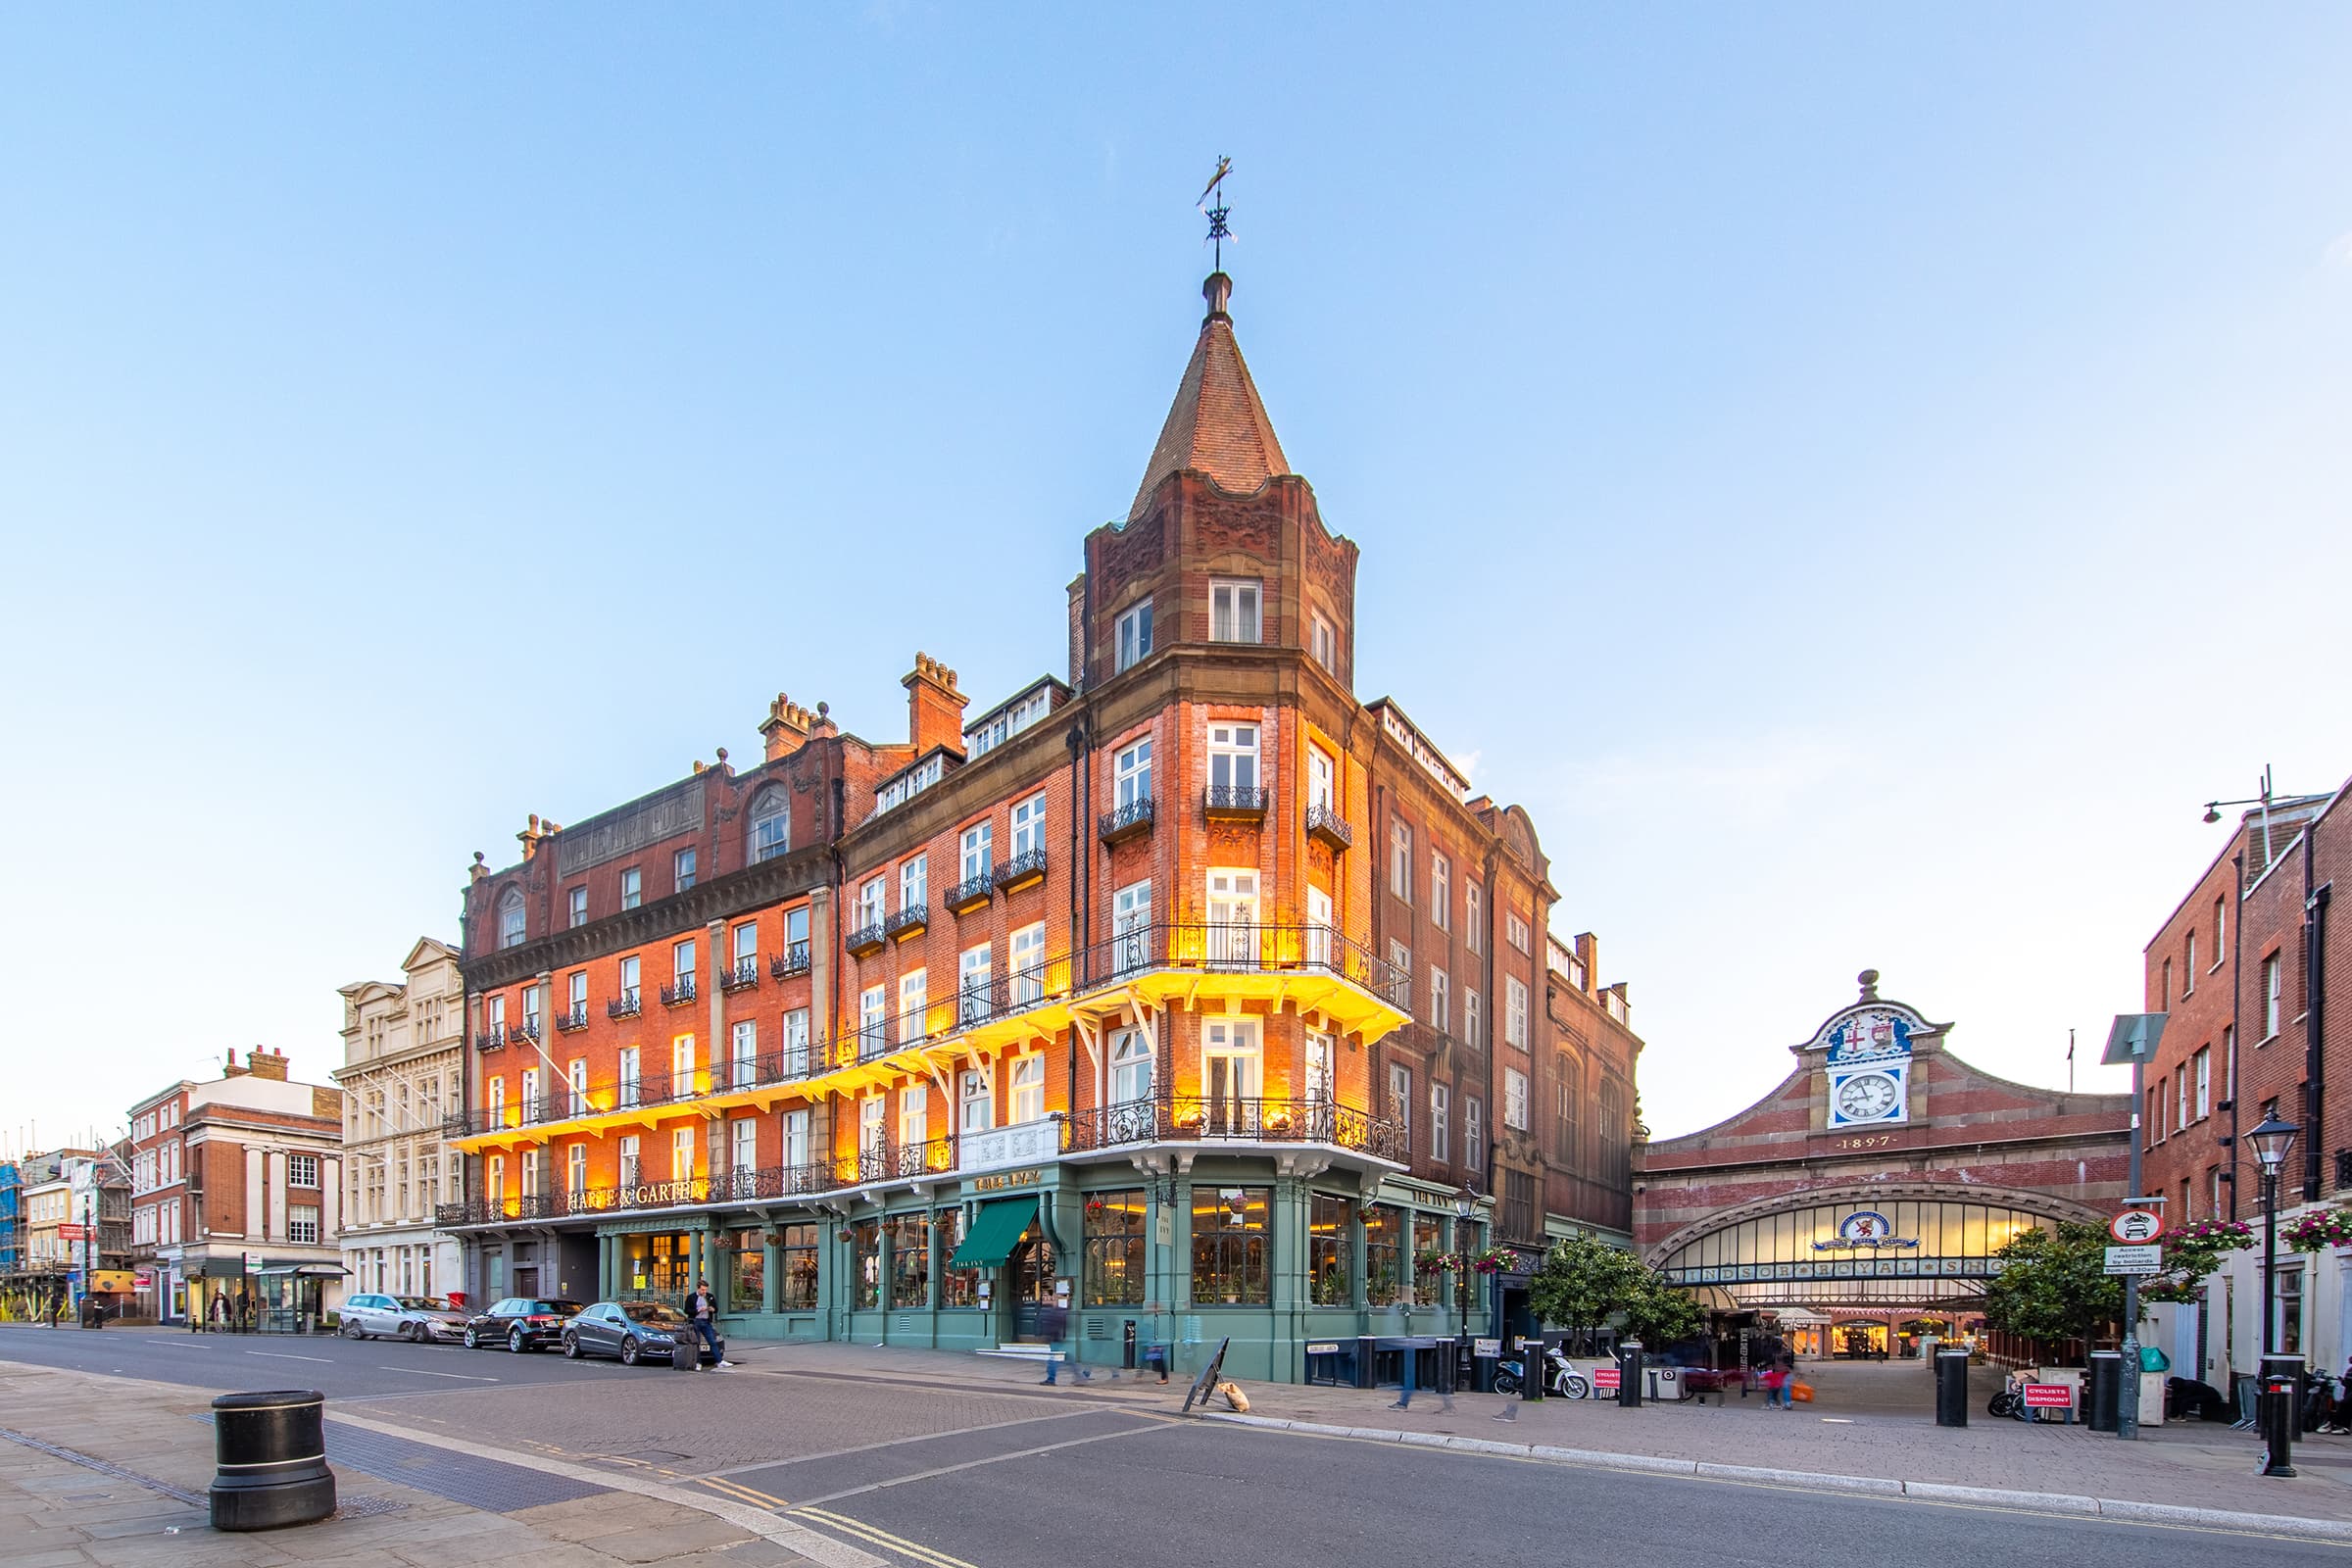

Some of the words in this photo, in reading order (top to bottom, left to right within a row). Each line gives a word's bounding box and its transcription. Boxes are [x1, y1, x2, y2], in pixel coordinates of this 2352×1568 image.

[612, 815, 645, 850] HART
[566, 1189, 617, 1210] HARTE
[636, 1179, 704, 1204] GARTER
[973, 1175, 1004, 1193] THE
[1008, 1168, 1042, 1187] IVY
[1671, 1266, 1789, 1282] WINDSOR
[1818, 1262, 1915, 1276] ROYAL
[1945, 1260, 2004, 1275] SHO
